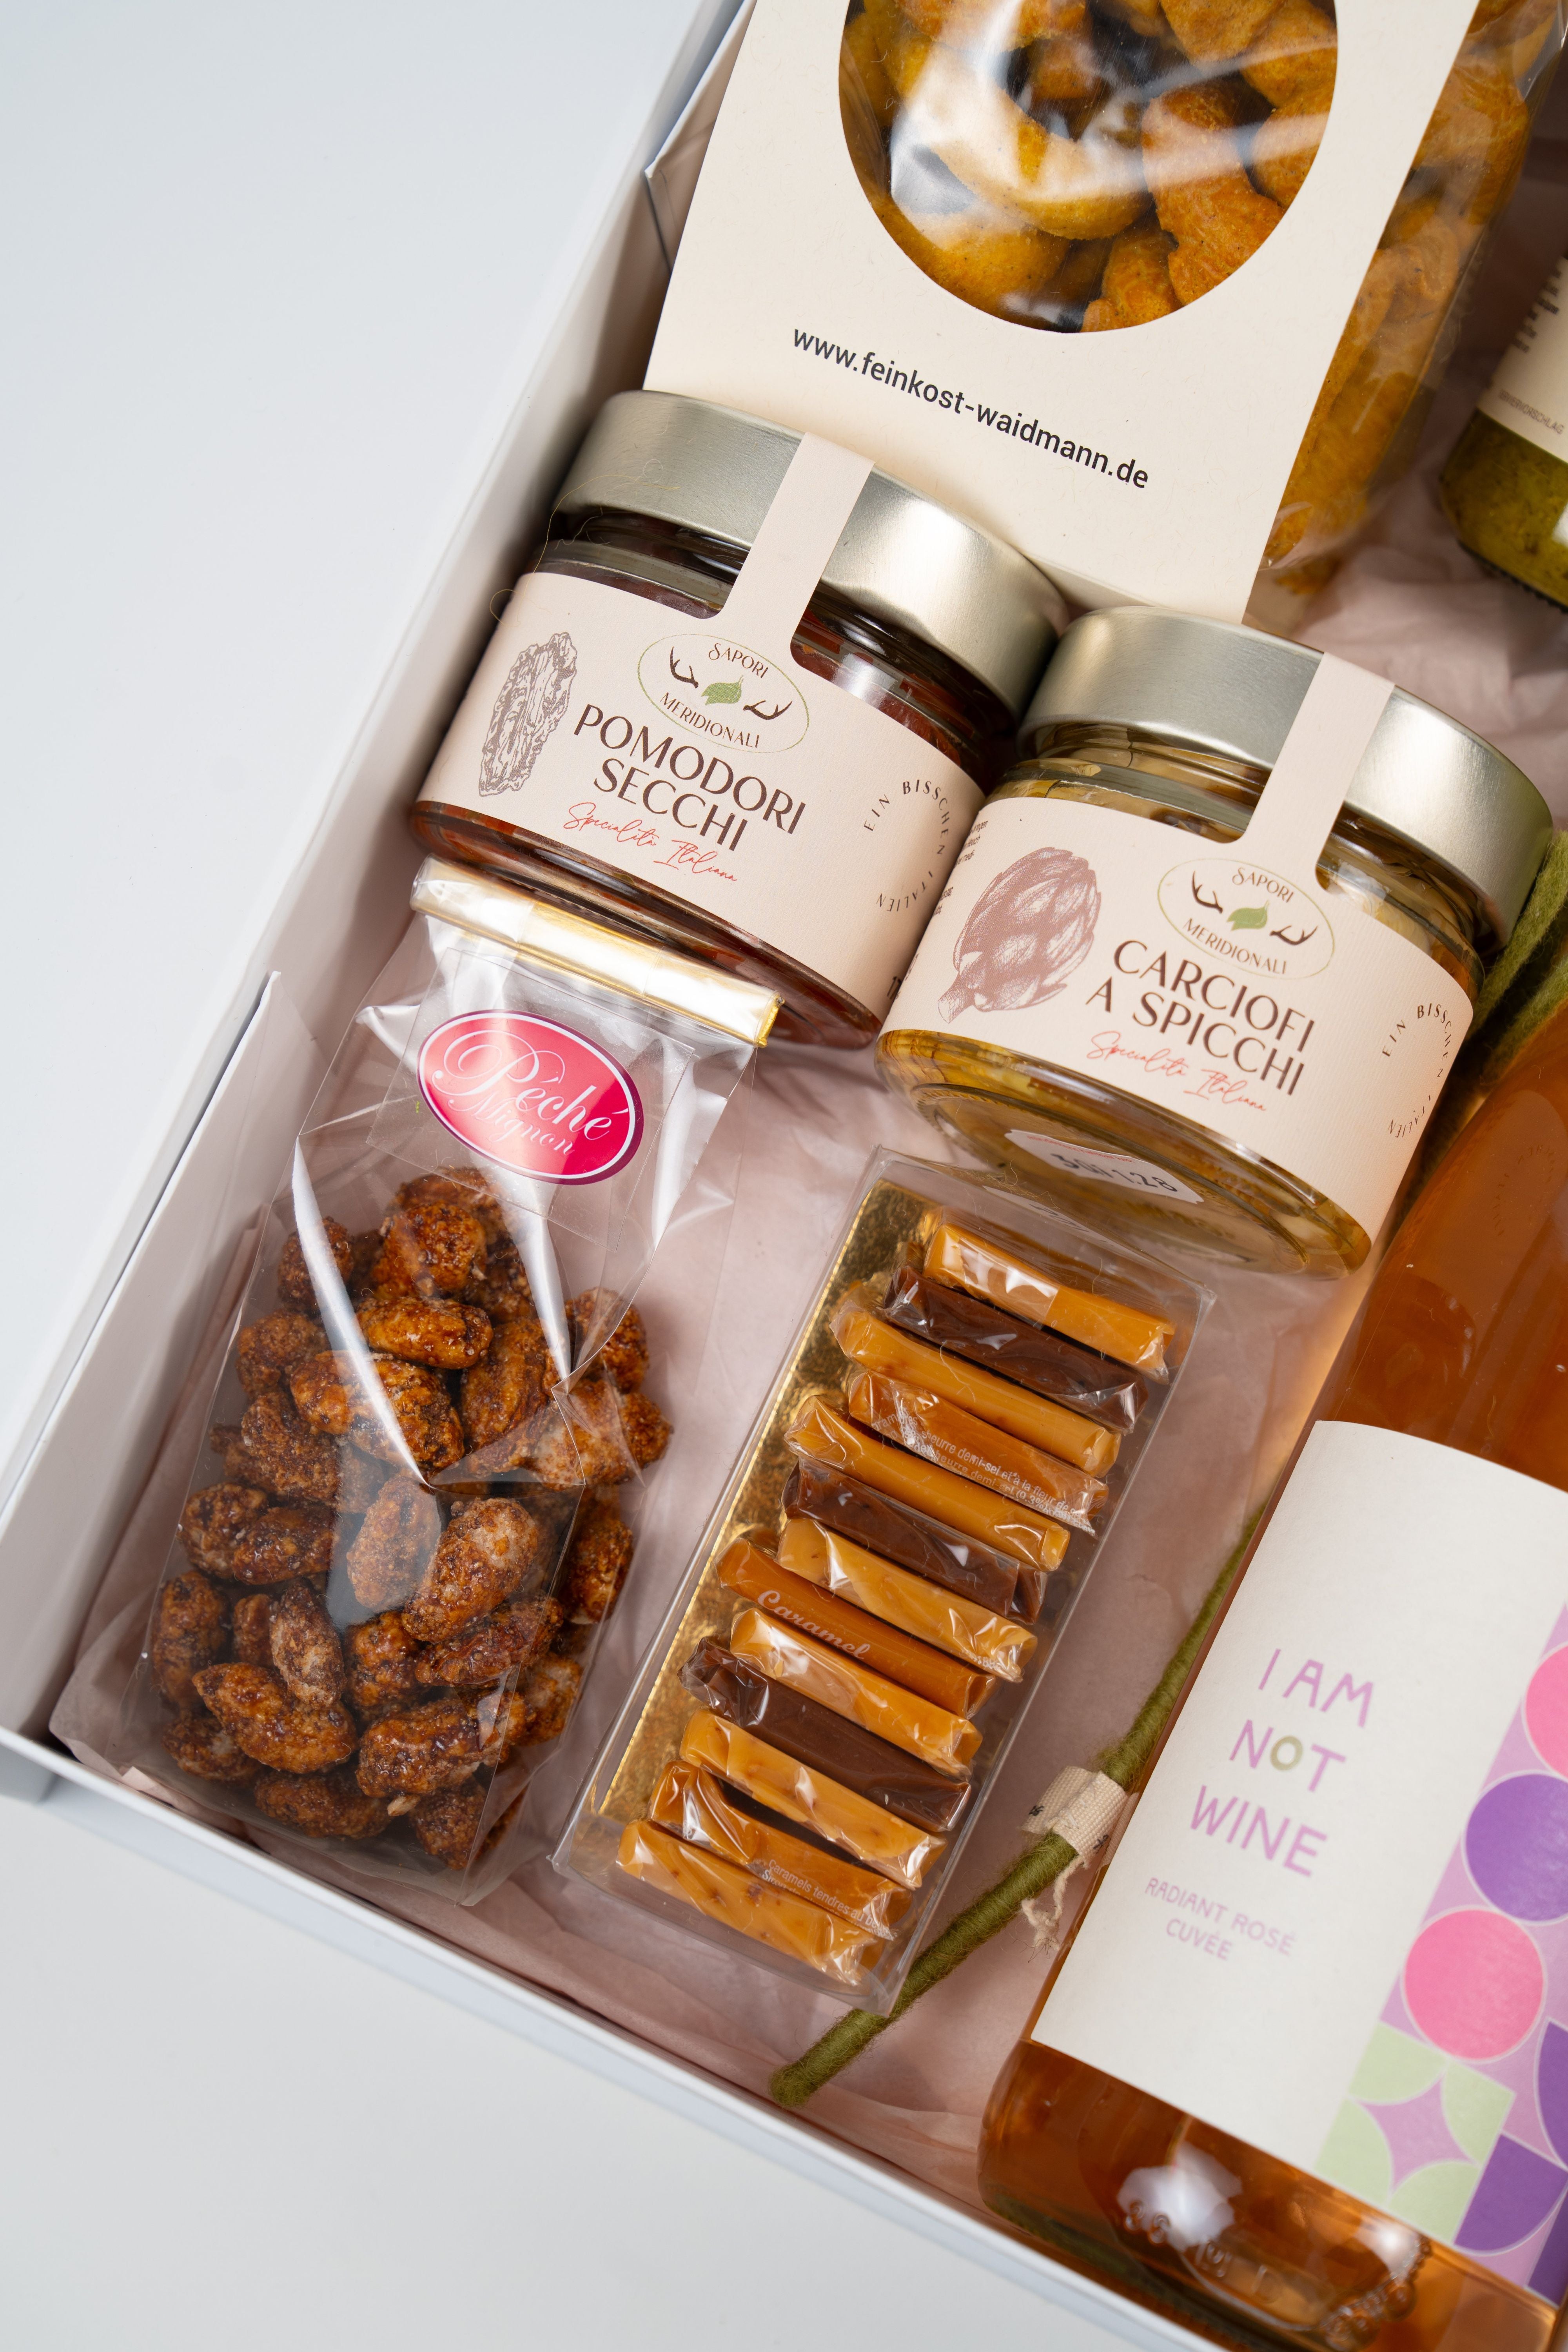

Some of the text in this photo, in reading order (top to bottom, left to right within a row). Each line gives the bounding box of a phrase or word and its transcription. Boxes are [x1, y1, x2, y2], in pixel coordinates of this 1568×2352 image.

[793, 328, 1149, 488] www.feinkost-waidmann.de
[708, 642, 768, 678] SAPORI
[660, 692, 760, 748] MERIDIONALI
[574, 704, 806, 834] POMODORI
[593, 758, 748, 851] SECCHI
[563, 802, 737, 882] Specialità Italiana
[864, 779, 949, 911] EIN BISSCHEN ITALIEN
[1232, 867, 1294, 903] SAPORI
[1183, 918, 1288, 974] MERIDIONALI
[1085, 977, 1305, 1096] A SPICCHI
[1114, 940, 1315, 1053] CARCIOFI
[432, 1030, 628, 1140] Péché
[1087, 1031, 1266, 1111] Specialità Italiana
[1382, 1003, 1451, 1138] EIN BISSCHEN ITALIEN
[448, 1094, 574, 1155] Mignon
[1022, 1479, 1032, 1491] la
[1034, 1486, 1056, 1504] fleur
[757, 1590, 870, 1659] Caramel
[1258, 1648, 1374, 1728] I AM
[1229, 1720, 1346, 1792] NOT
[1190, 1785, 1328, 1877] WINE
[769, 1859, 812, 1893] Caramels
[814, 1887, 849, 1915] tendres
[850, 1909, 864, 1922] au
[1145, 1878, 1296, 1956] RADIANT ROSÉ
[1166, 1918, 1232, 1960] CUVÉE
